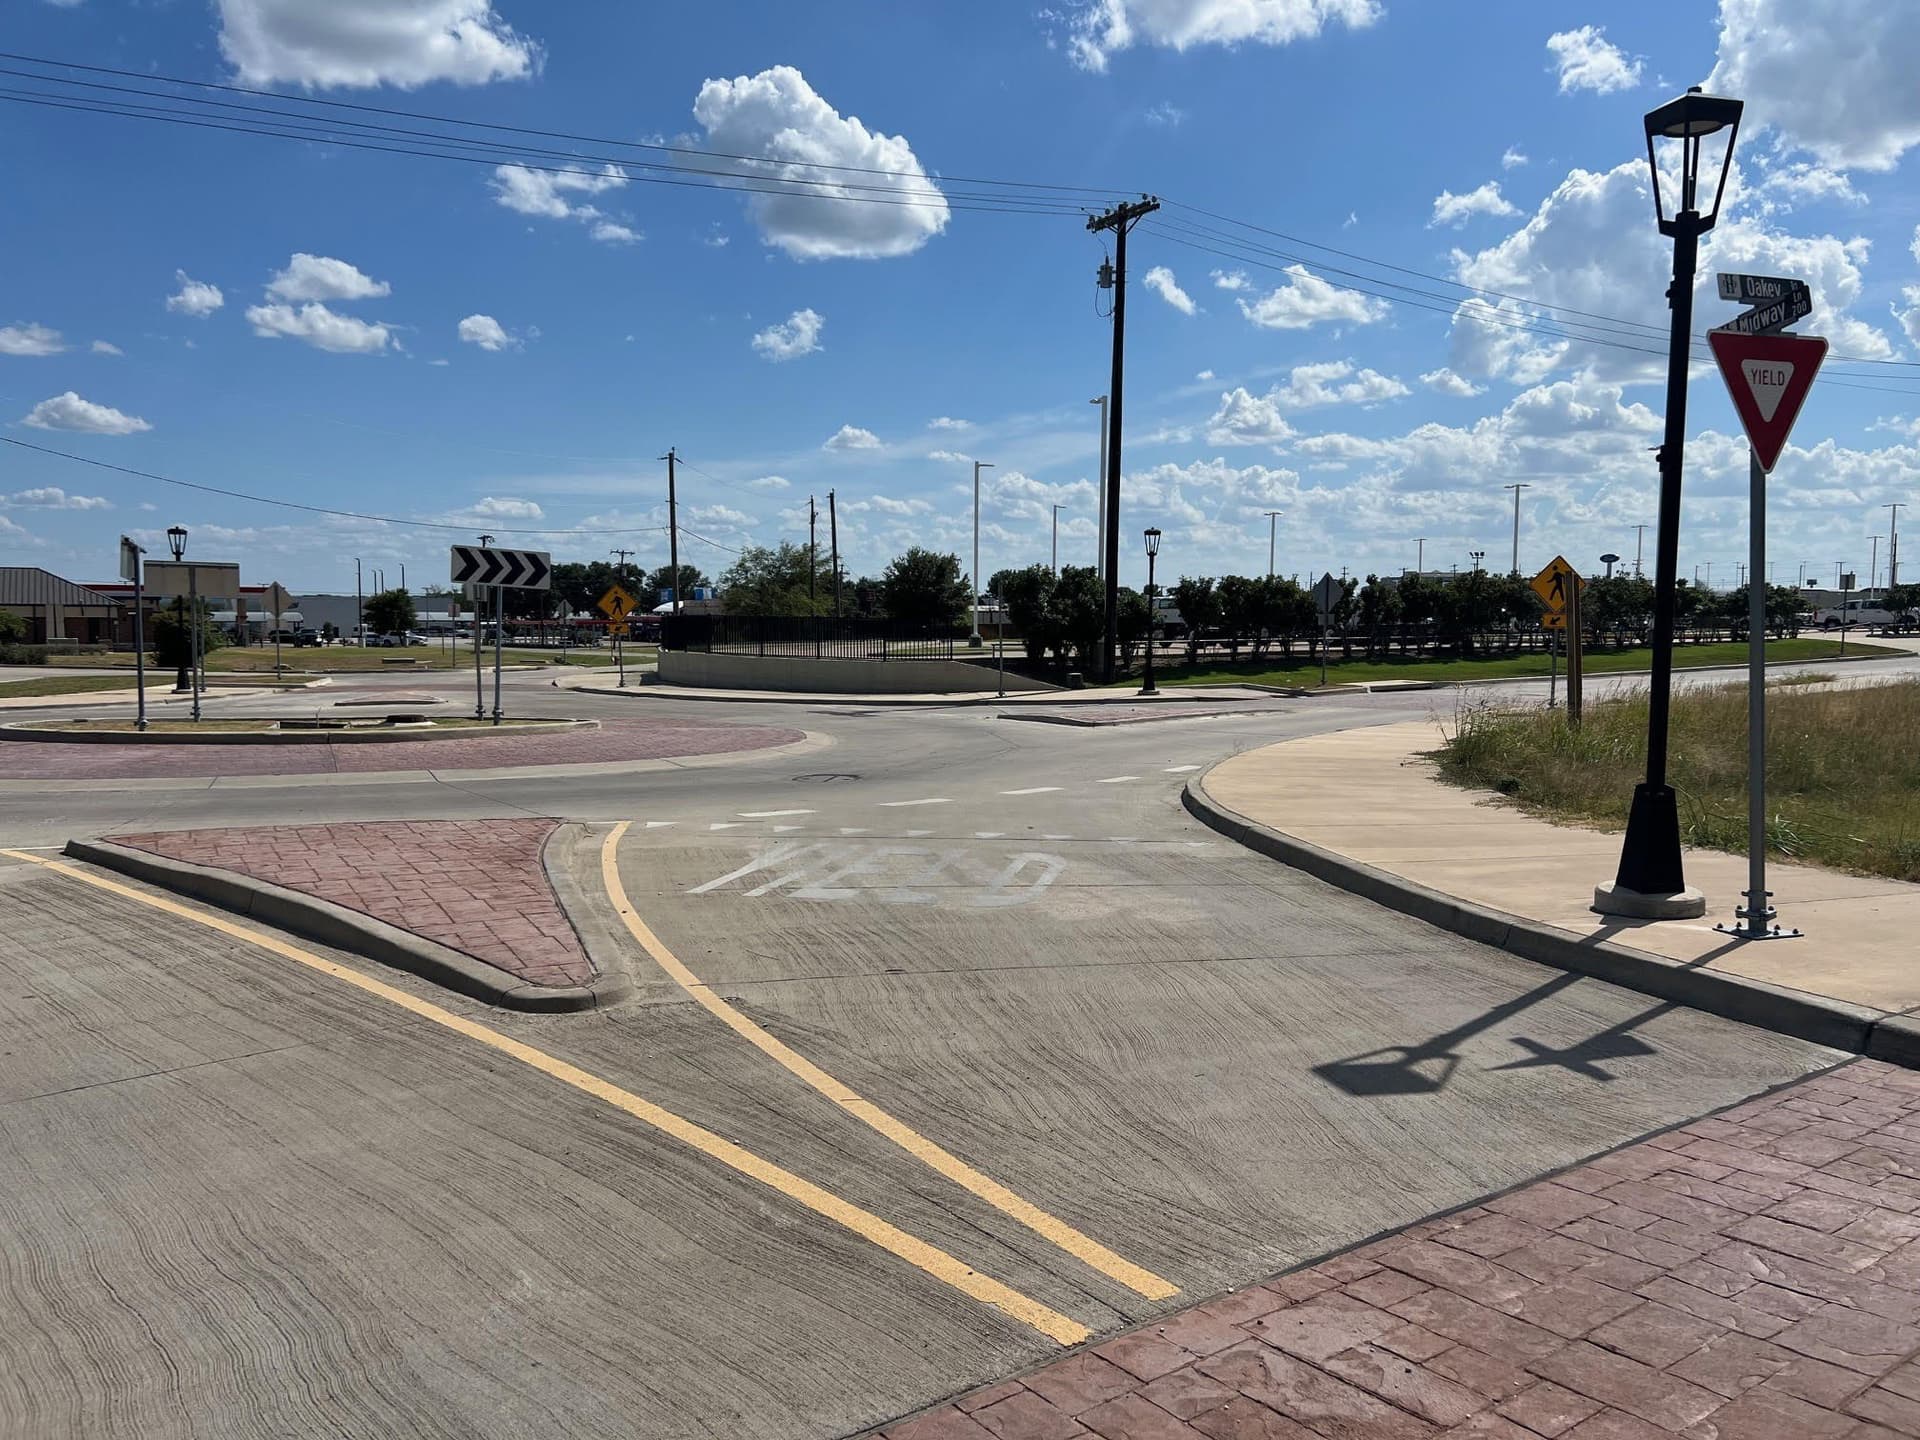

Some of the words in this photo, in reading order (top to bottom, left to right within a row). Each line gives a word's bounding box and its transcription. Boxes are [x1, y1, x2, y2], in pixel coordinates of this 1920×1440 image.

[1746, 277, 1781, 298] Oakey
[1739, 301, 1785, 333] Midway
[1751, 368, 1785, 386] YIELD
